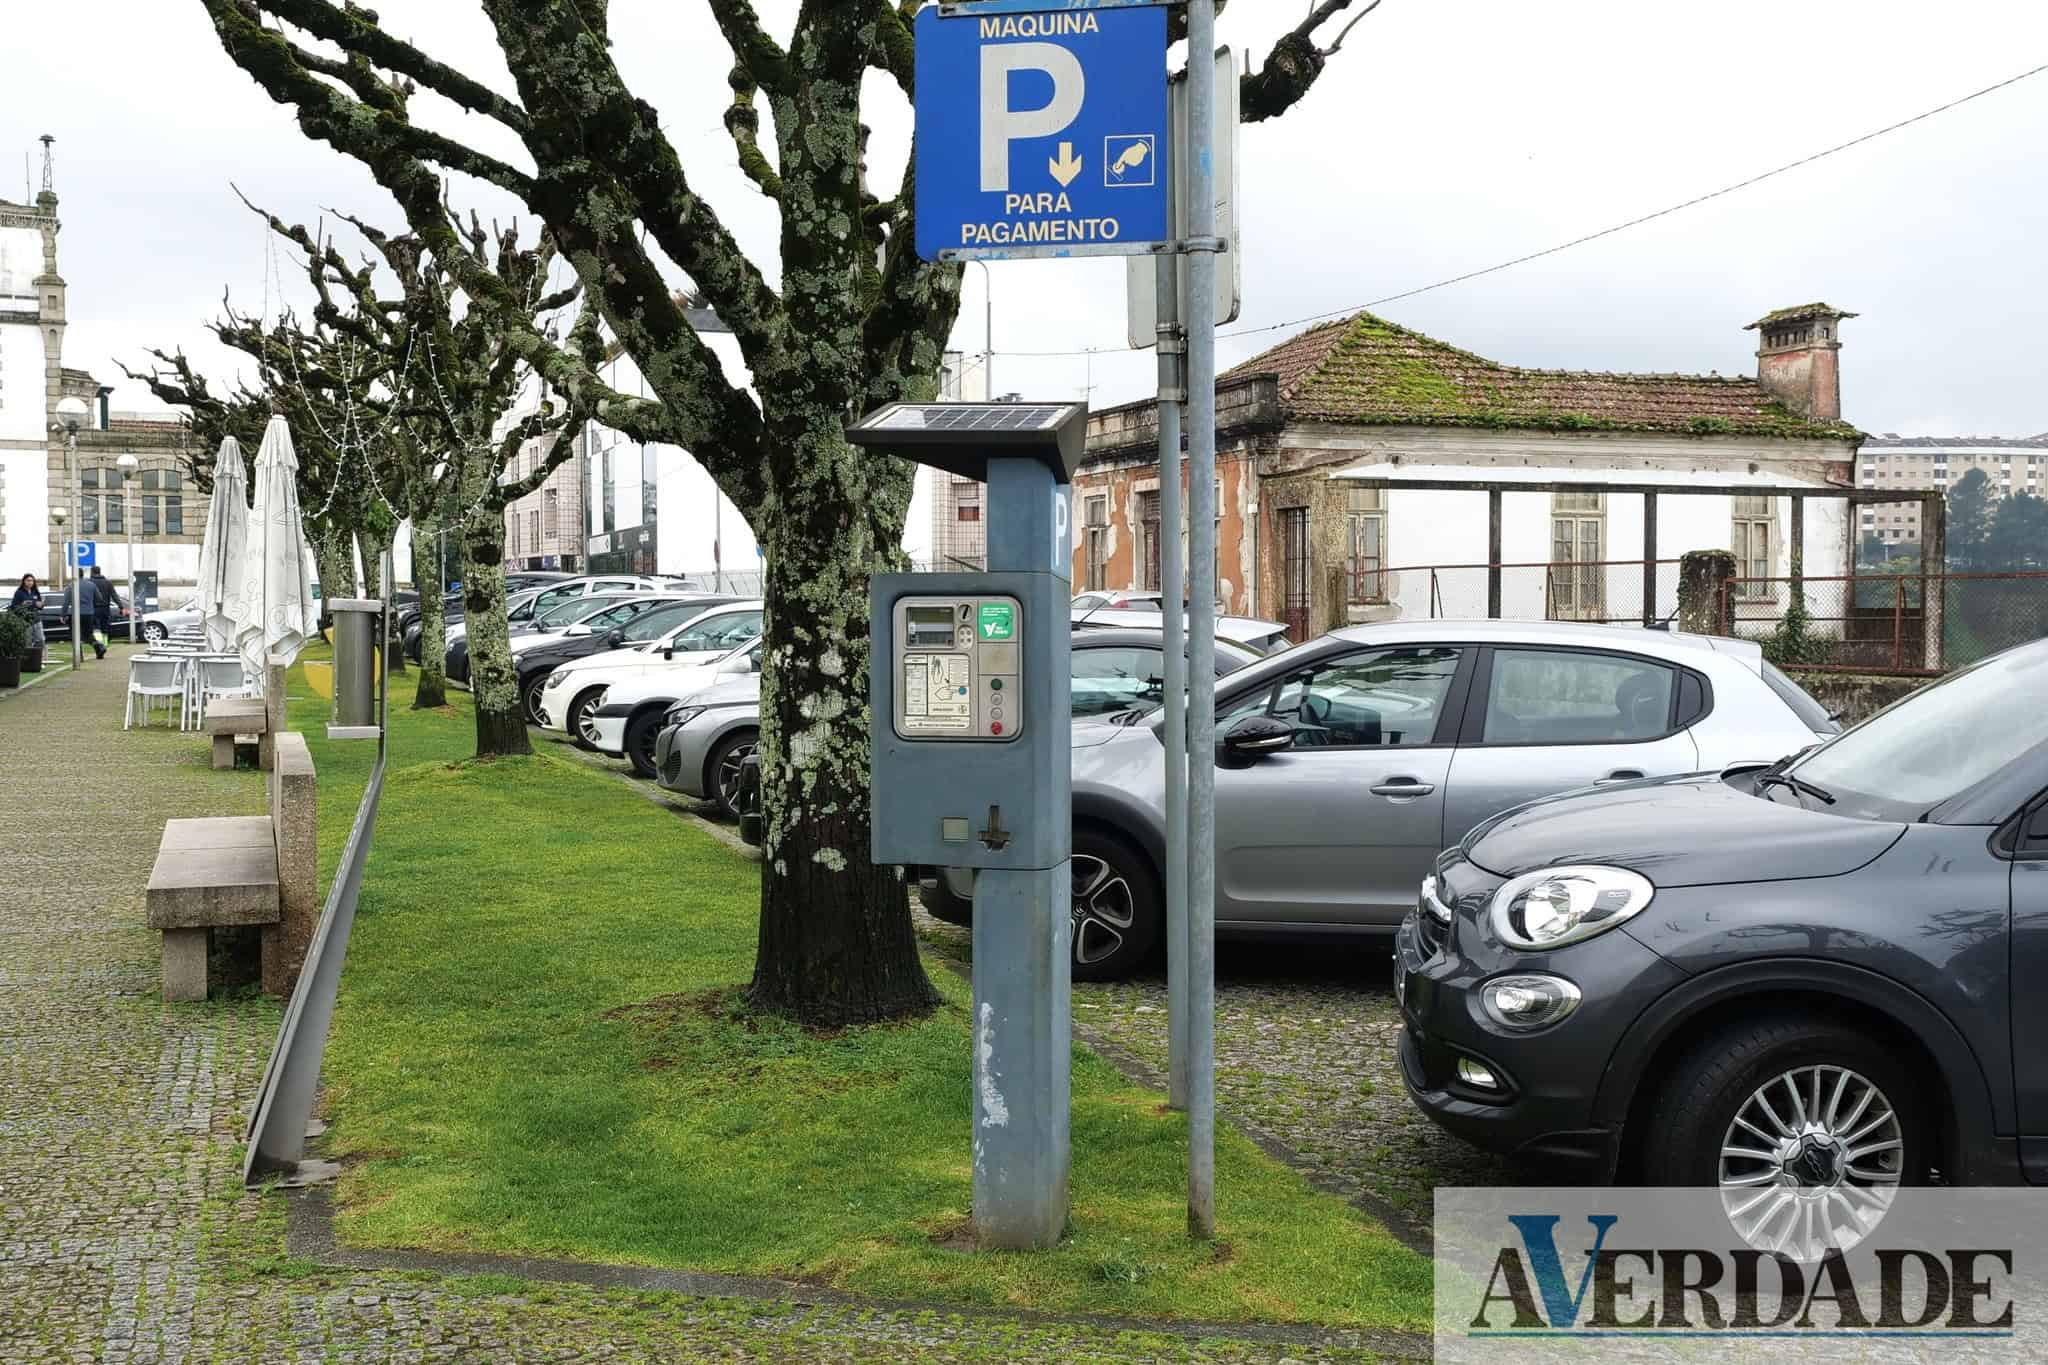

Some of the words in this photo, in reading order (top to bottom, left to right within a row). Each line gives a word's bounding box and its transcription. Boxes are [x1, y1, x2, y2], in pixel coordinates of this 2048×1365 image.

[979, 13, 1100, 39] MAQUINA
[980, 42, 1085, 192] P
[1005, 193, 1072, 215] PARA
[961, 217, 1120, 244] PAGAMENTO
[1055, 493, 1068, 567] P
